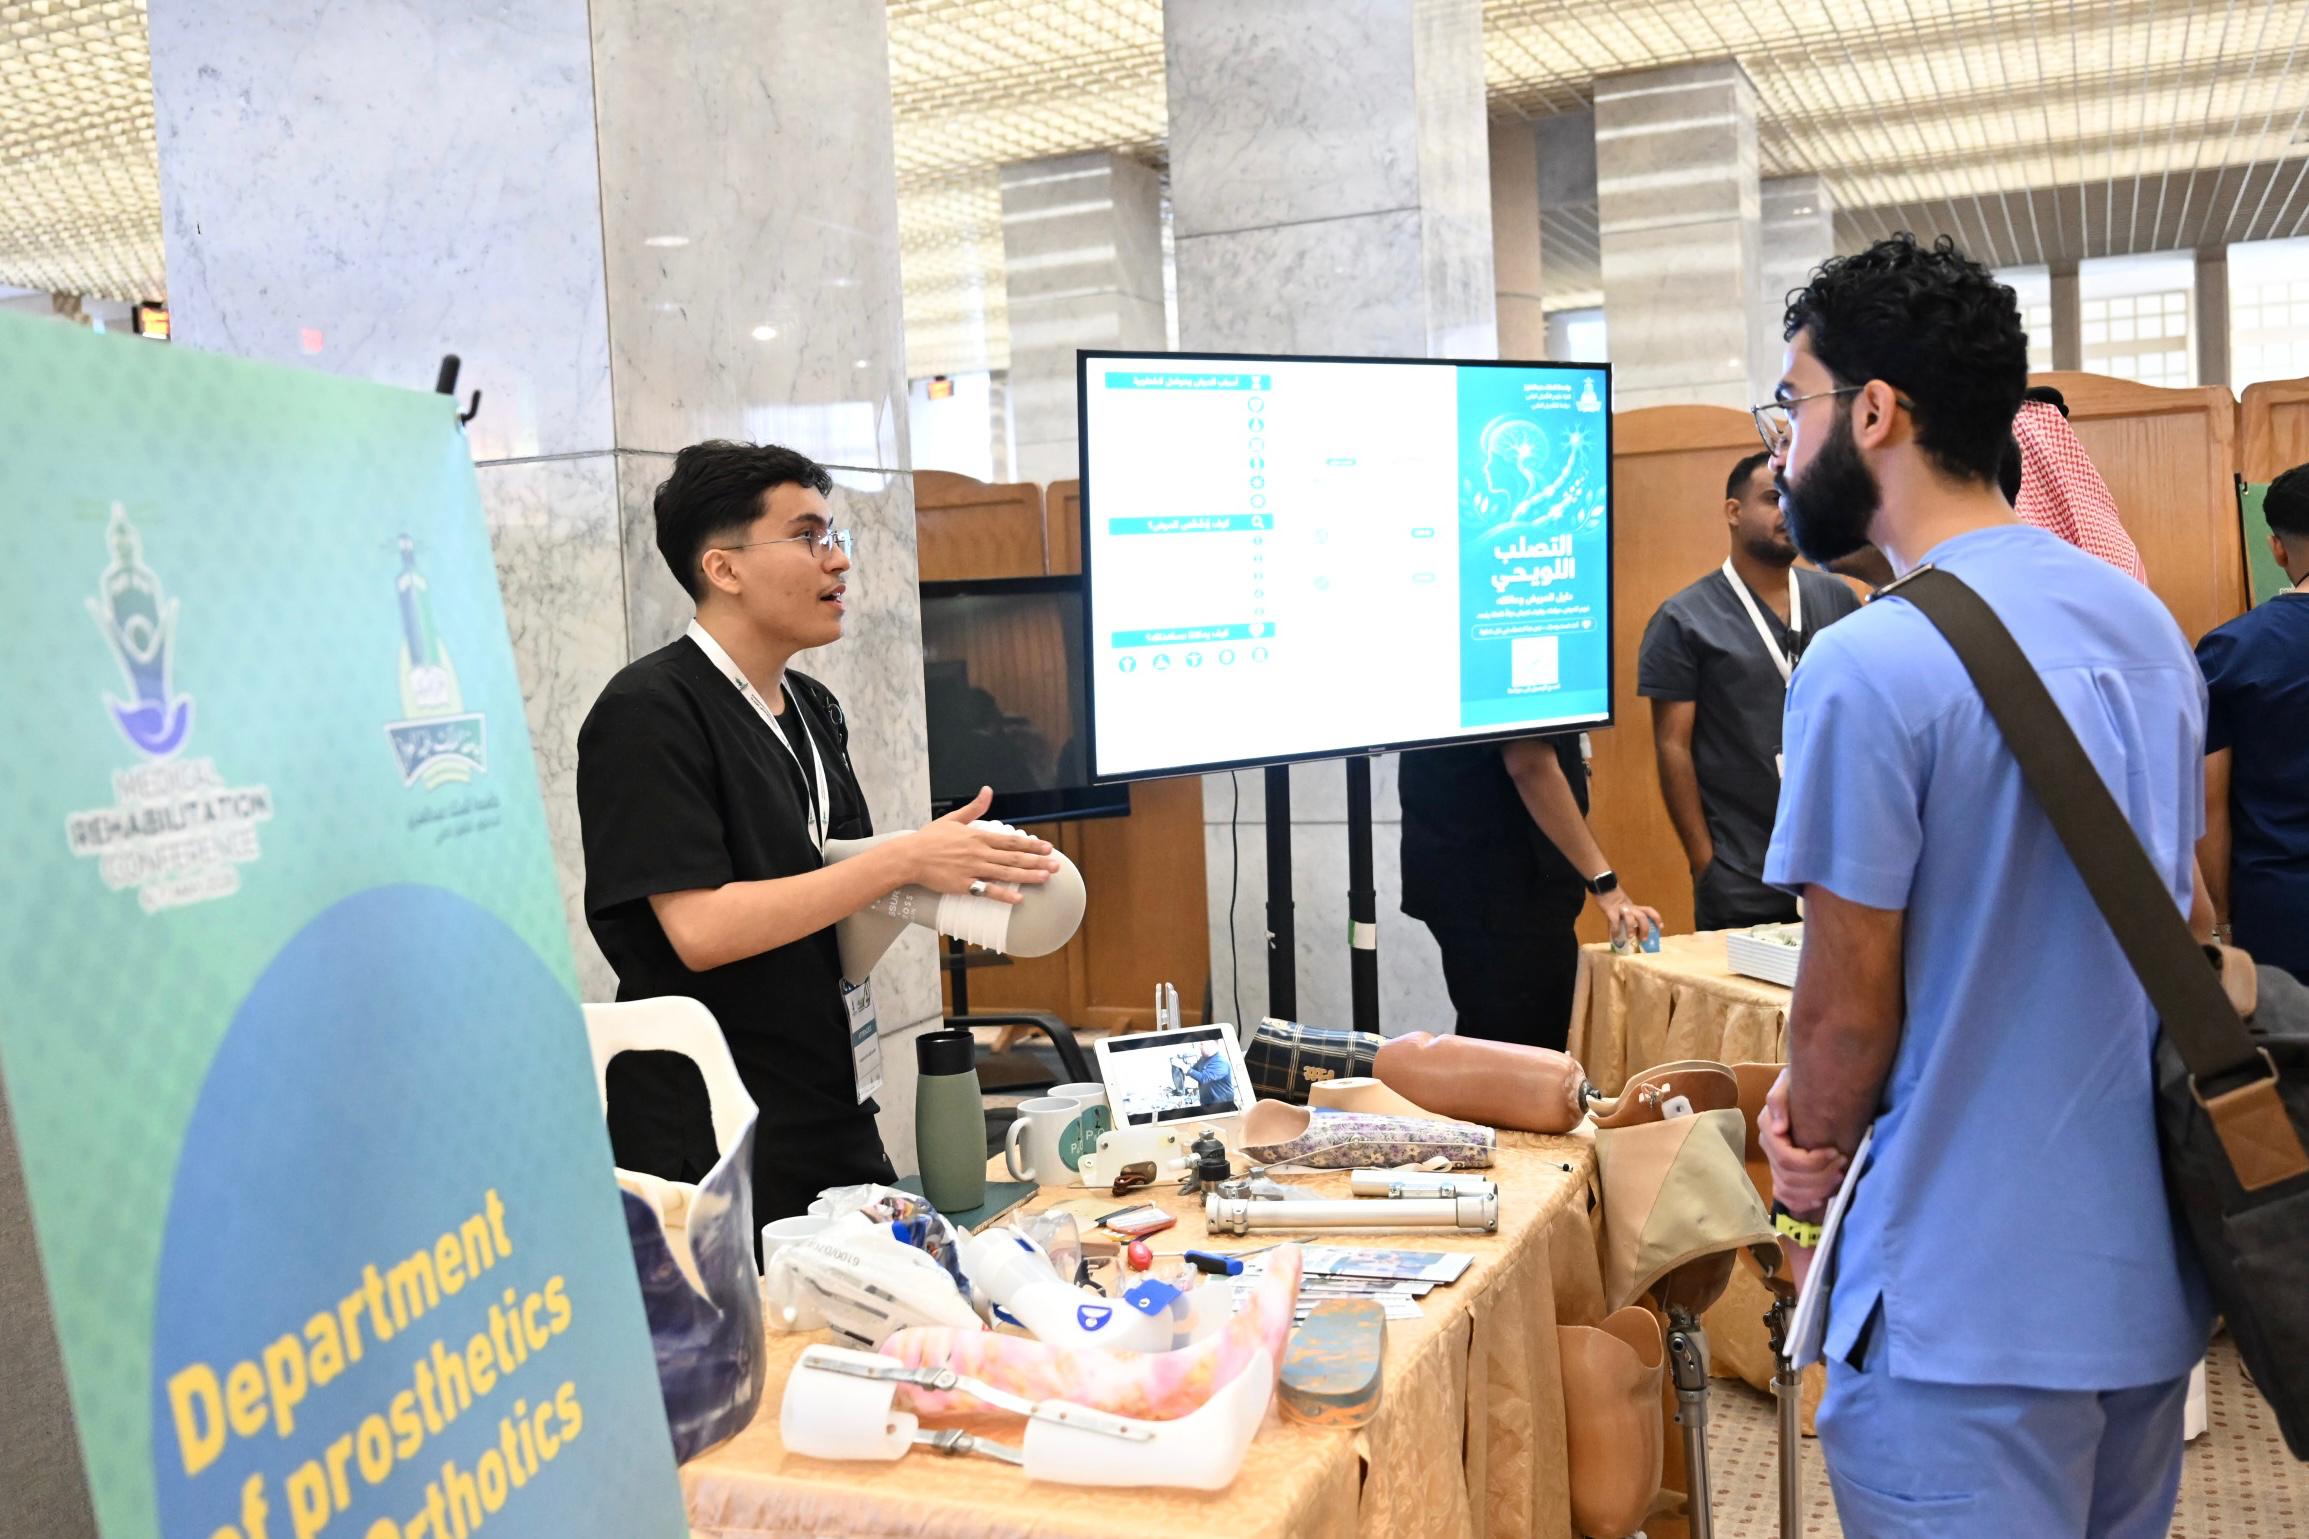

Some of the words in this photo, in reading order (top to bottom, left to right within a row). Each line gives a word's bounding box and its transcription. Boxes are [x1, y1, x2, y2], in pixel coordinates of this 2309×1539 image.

[1491, 557, 1576, 593] اللويحي
[1494, 533, 1573, 565] التصلب
[71, 793, 268, 847] REHABILITATION
[165, 1189, 512, 1478] Department
[285, 1275, 573, 1539] prosthetics
[363, 1380, 584, 1539] rthotics
